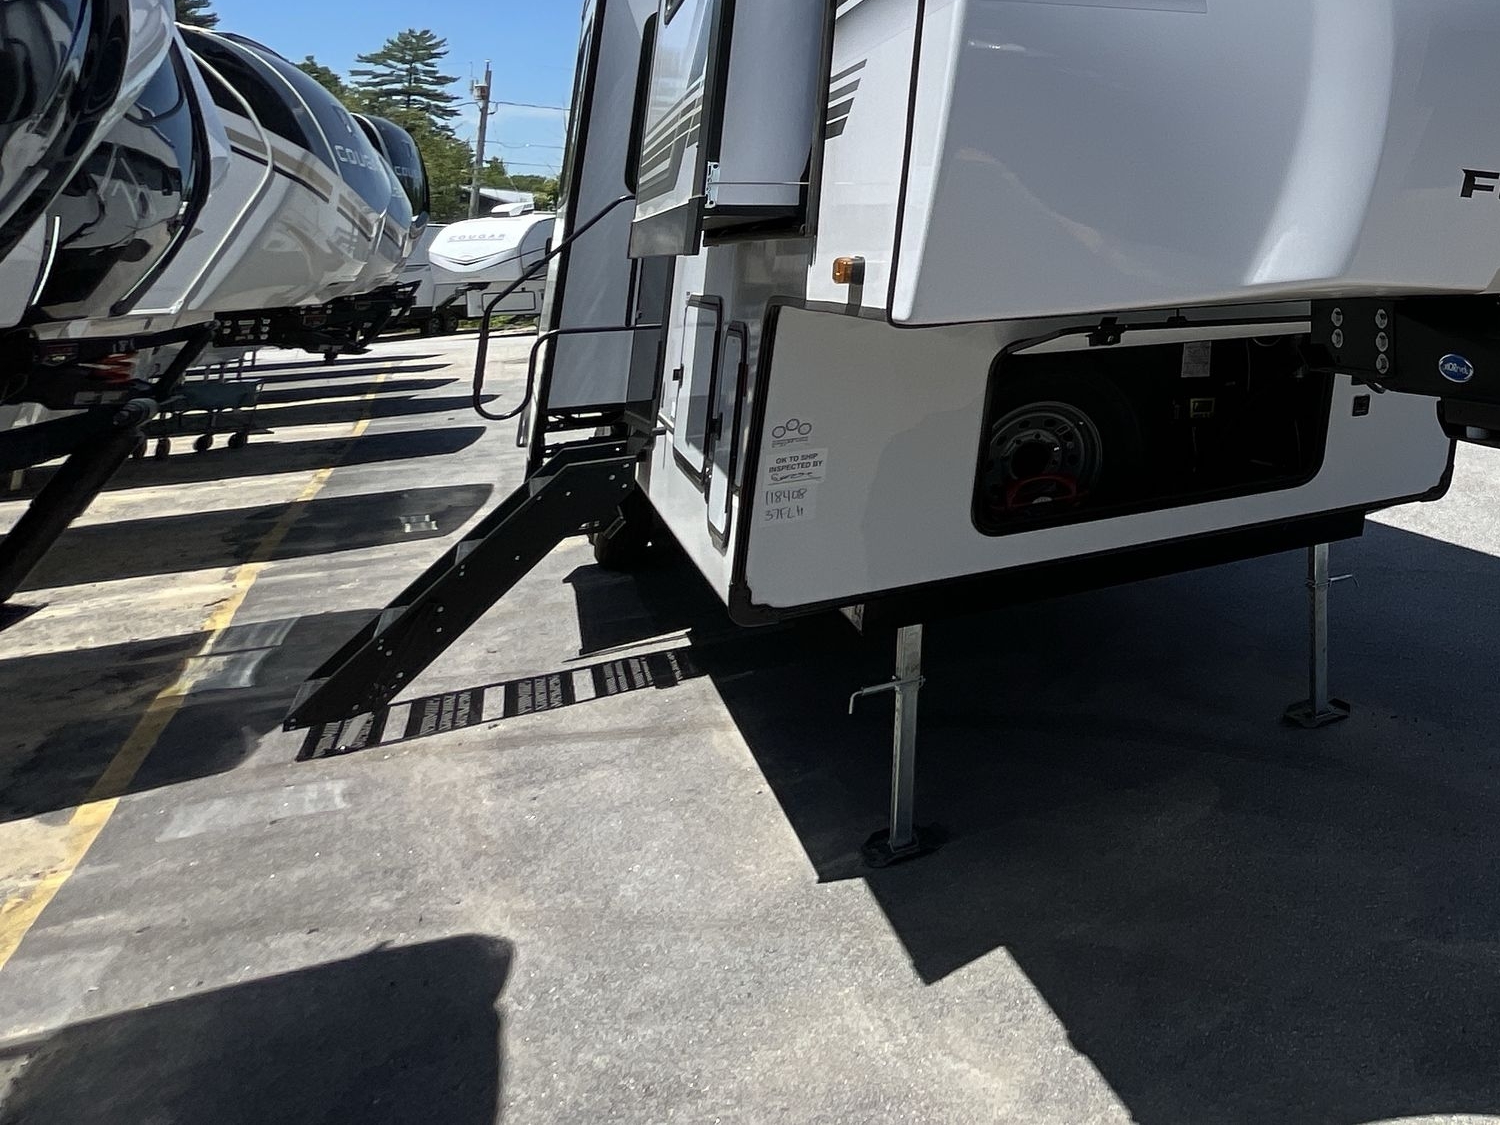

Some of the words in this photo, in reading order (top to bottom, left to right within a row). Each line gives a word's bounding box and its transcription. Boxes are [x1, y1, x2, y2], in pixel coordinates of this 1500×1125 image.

[776, 457, 787, 465] OK
[789, 455, 799, 463] TO
[801, 453, 818, 461] SHIP
[769, 462, 811, 473] INSPECTED
[813, 460, 823, 468] BY
